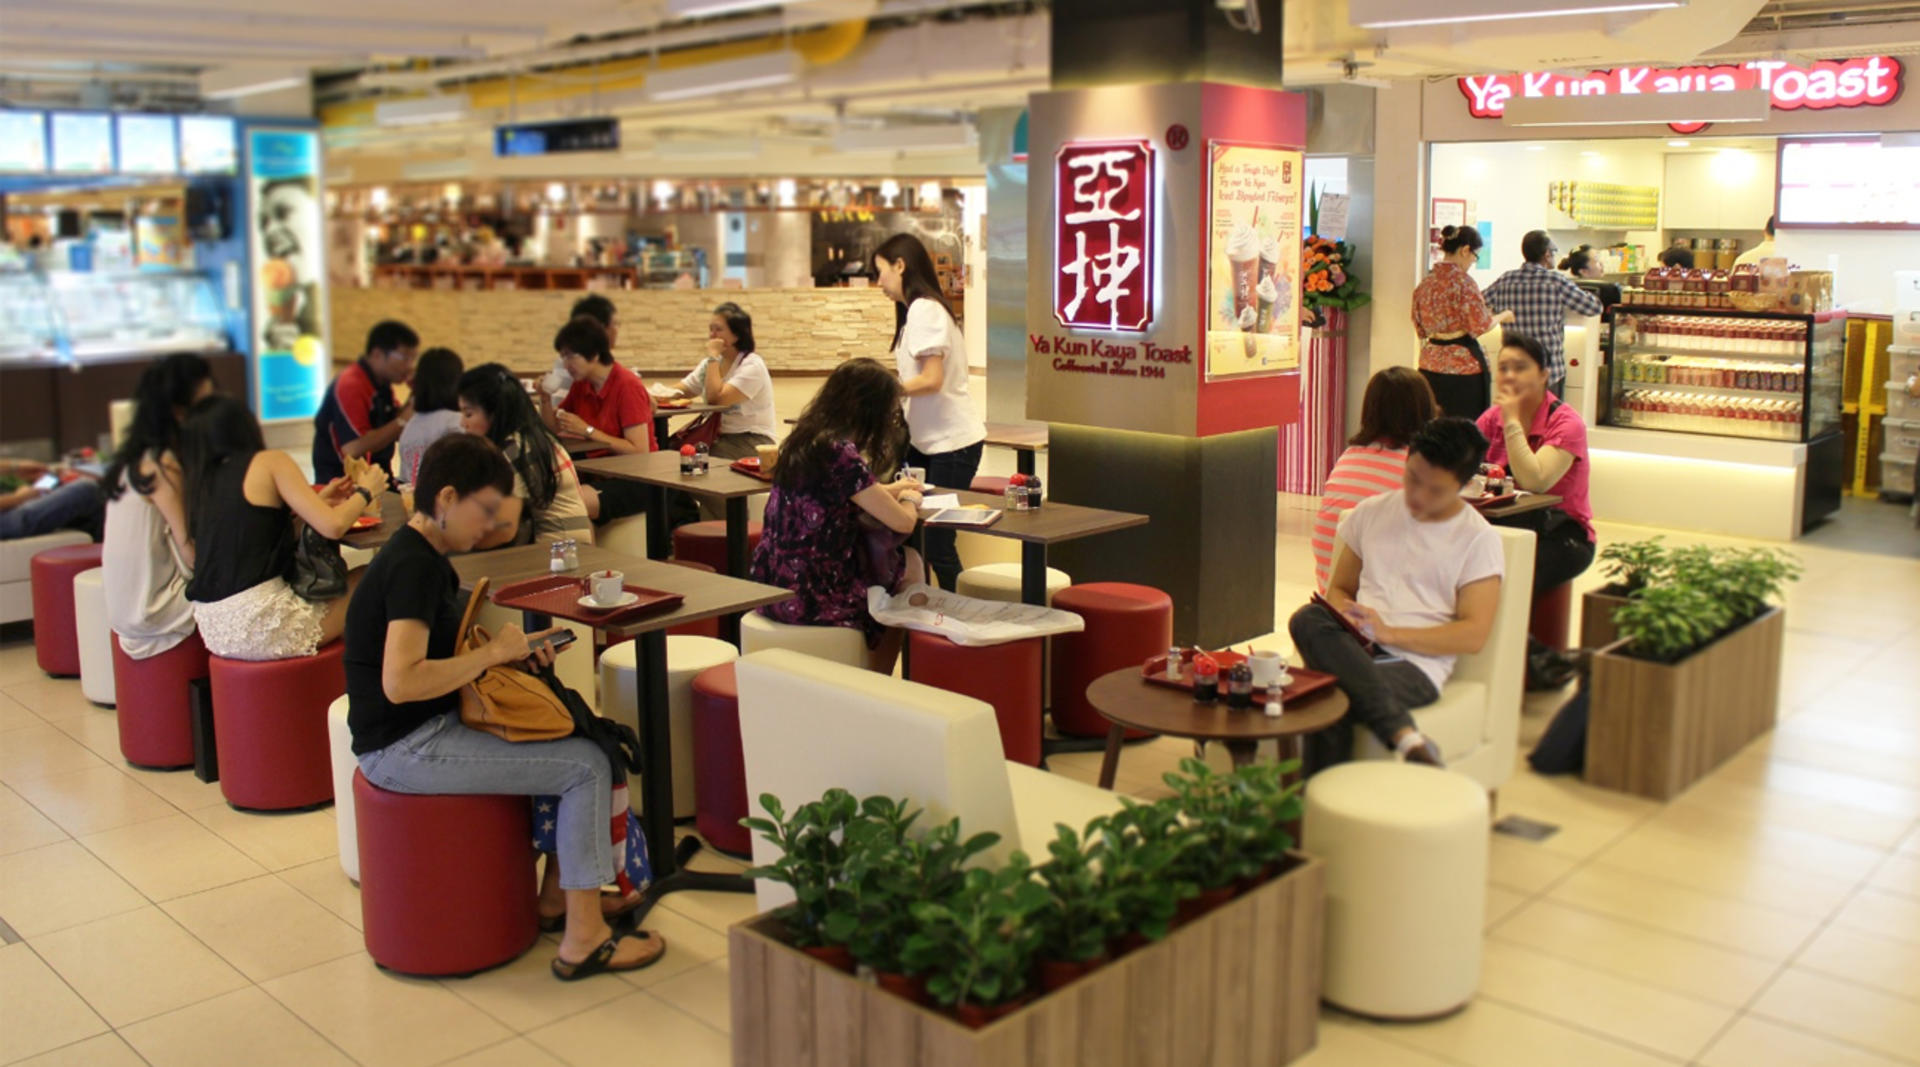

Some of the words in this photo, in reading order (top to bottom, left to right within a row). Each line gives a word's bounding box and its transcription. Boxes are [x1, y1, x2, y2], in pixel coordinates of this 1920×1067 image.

[1465, 75, 1511, 110] Ya
[1746, 57, 1889, 101] Toast
[1030, 334, 1050, 354] Ya
[1053, 336, 1087, 356] Kun
[1091, 338, 1137, 368] Kaya
[1140, 342, 1192, 363] Toast
